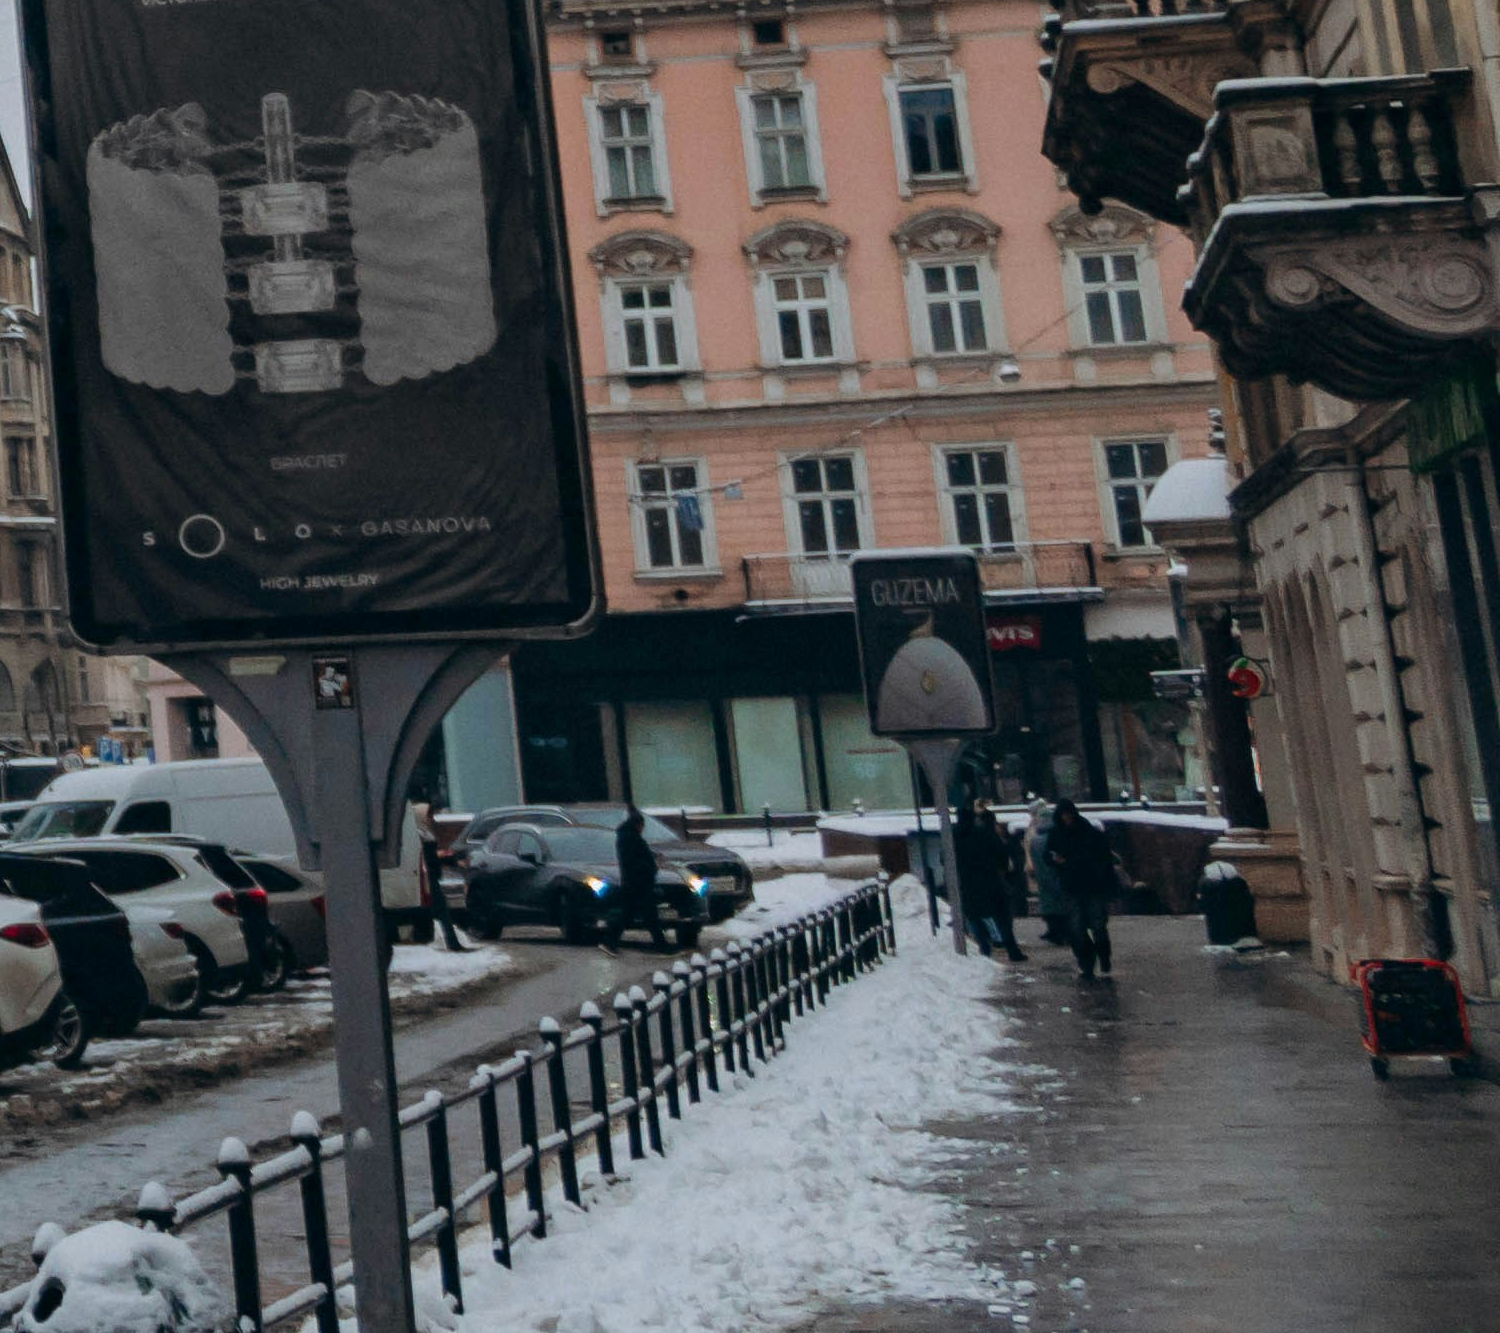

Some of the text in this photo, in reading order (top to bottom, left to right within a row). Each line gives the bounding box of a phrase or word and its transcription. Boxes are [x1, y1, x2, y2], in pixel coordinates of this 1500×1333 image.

[361, 516, 492, 537] GASANOVA
[260, 573, 380, 590] HIGH JEWELRY
[870, 577, 961, 606] GUZEMA
